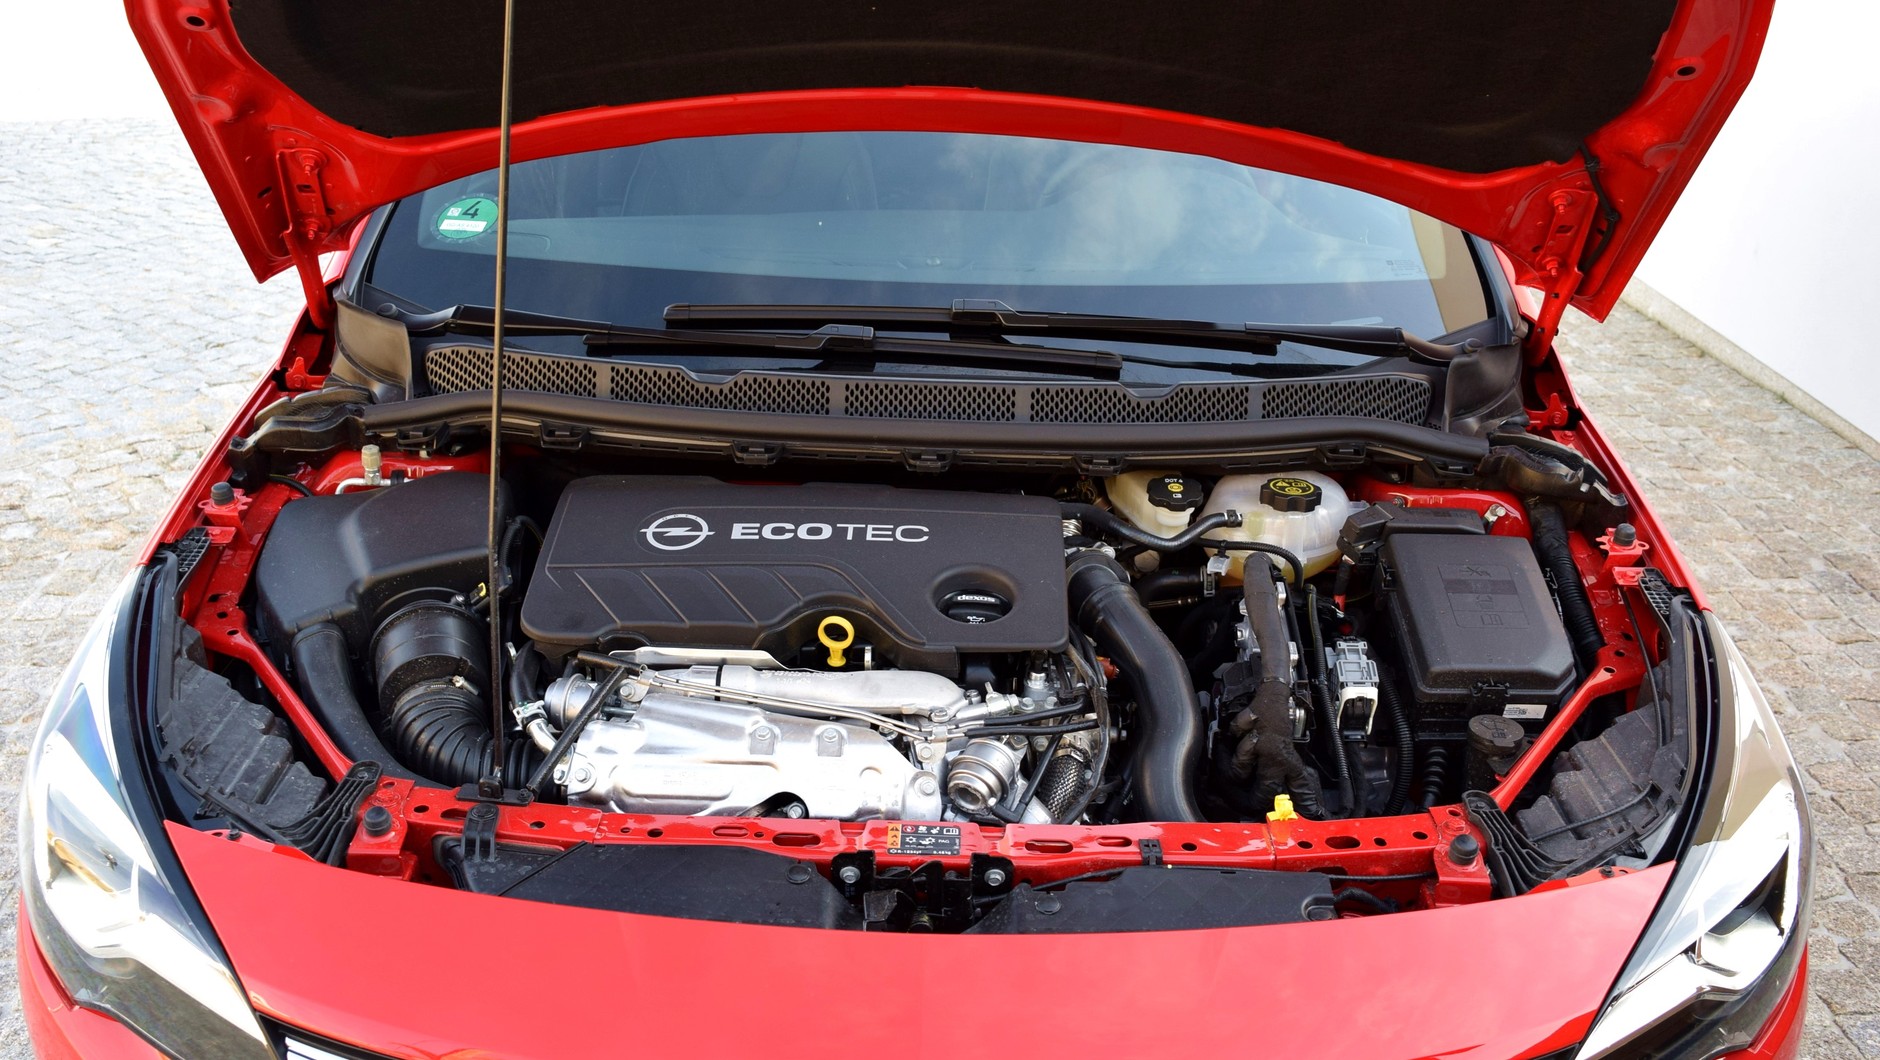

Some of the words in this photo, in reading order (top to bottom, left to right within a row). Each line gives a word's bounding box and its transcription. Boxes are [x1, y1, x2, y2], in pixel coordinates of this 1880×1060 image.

[462, 201, 482, 218] 4
[731, 522, 930, 543] ECOTEC
[957, 594, 995, 602] dexos
